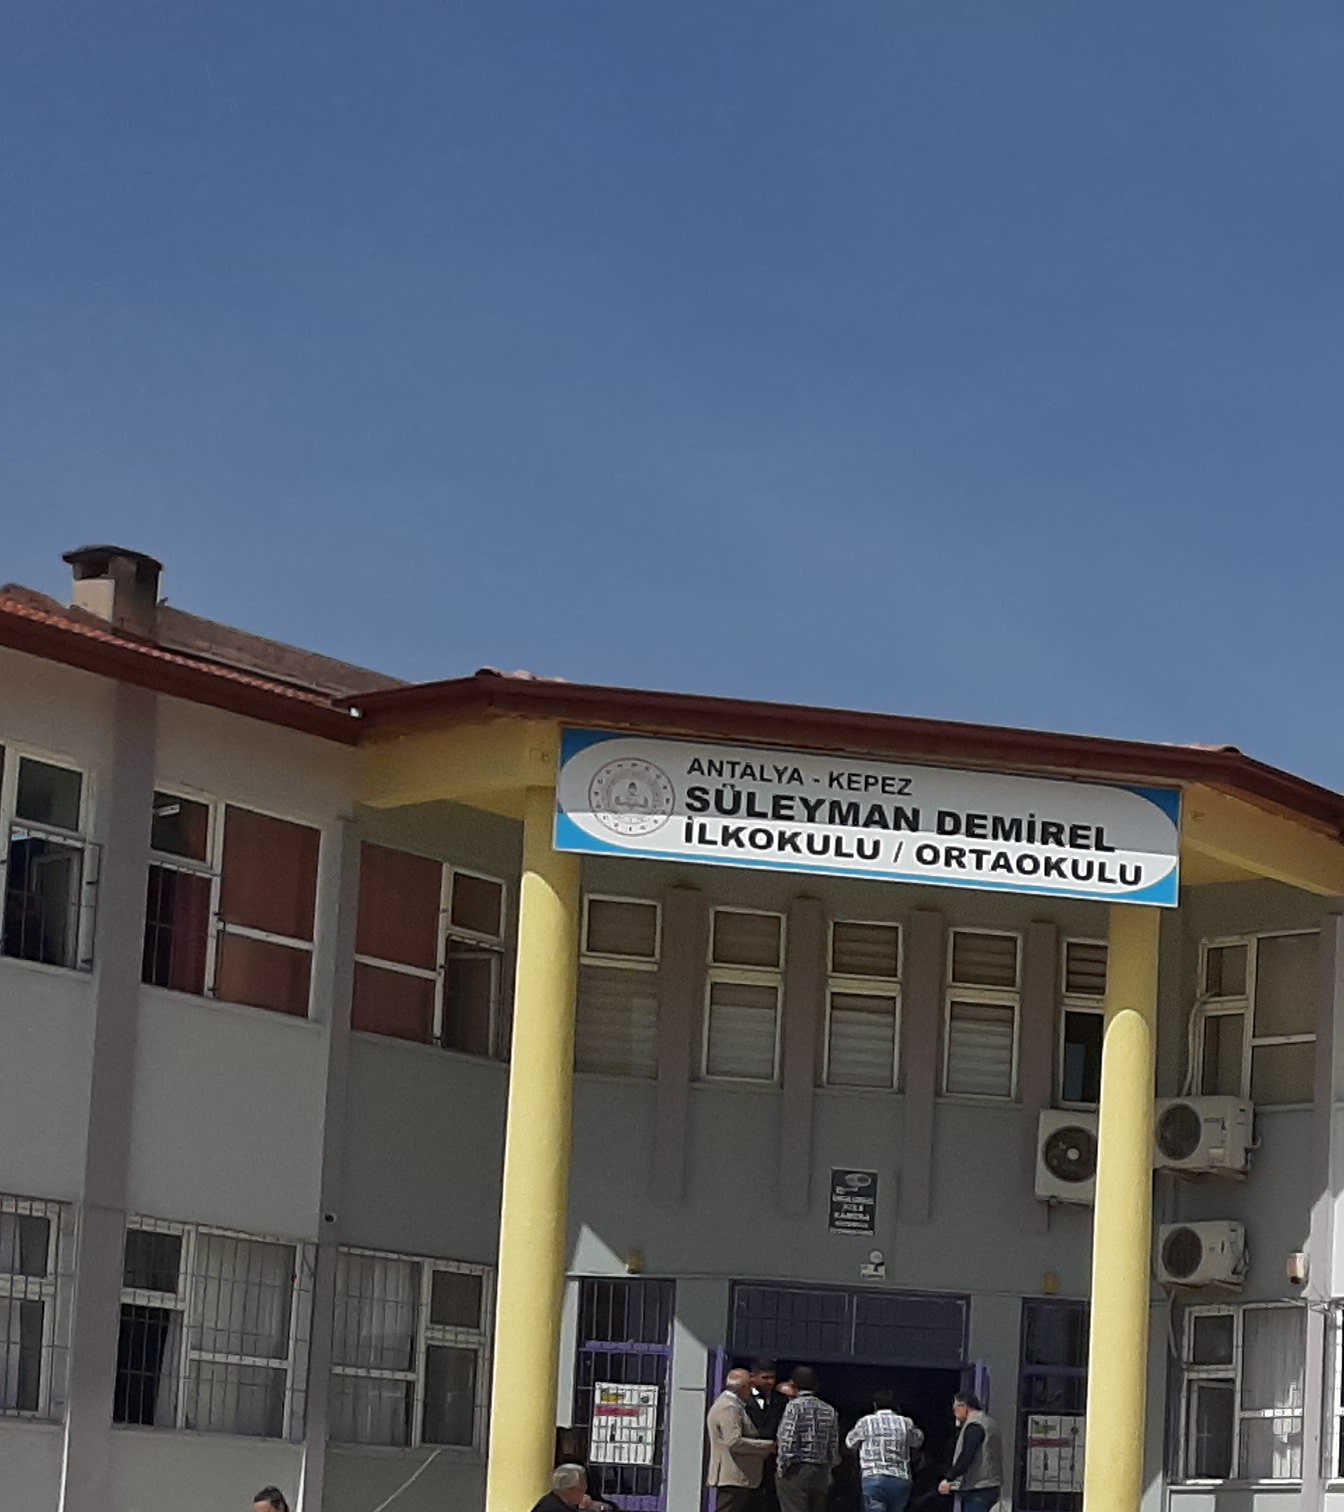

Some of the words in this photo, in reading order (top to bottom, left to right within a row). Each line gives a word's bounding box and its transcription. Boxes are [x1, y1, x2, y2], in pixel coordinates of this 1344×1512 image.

[686, 757, 805, 786] ANTALYA
[828, 770, 913, 796] KEPEZ
[684, 815, 881, 860] İLKOKULU
[892, 840, 904, 864] /
[914, 843, 1143, 887] ORTAOKULU
[685, 783, 921, 833] SÜLEYMAN
[936, 809, 1116, 853] DEMİREL
